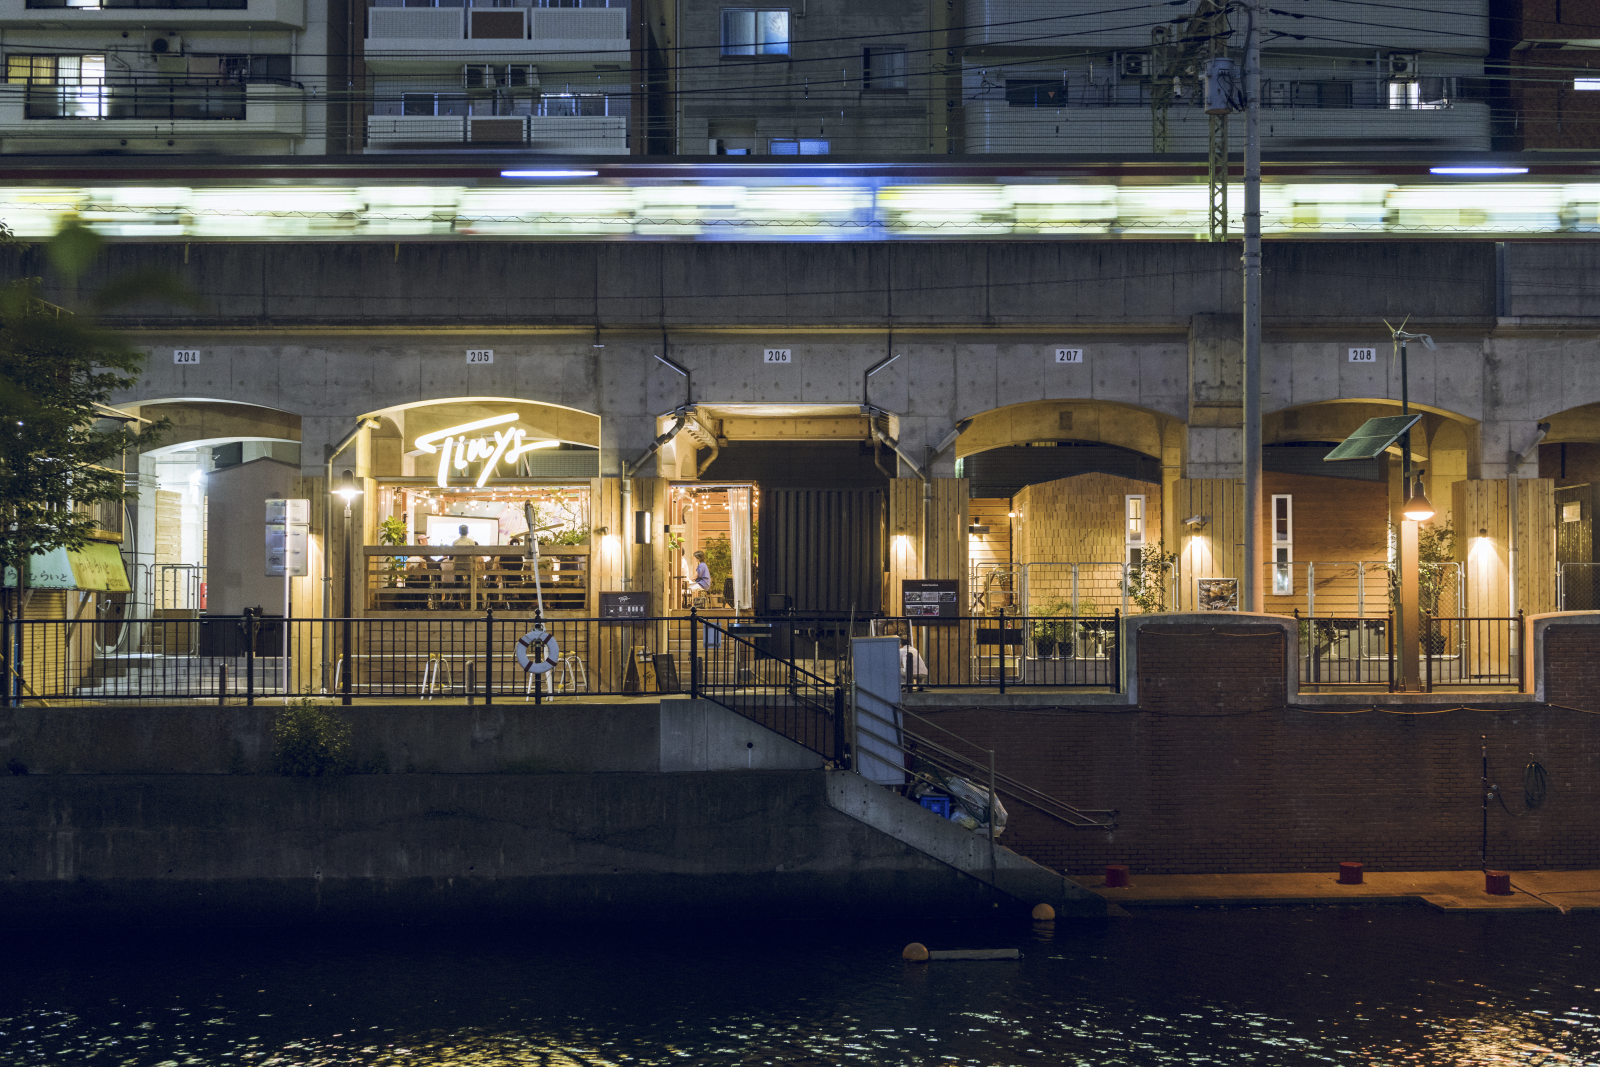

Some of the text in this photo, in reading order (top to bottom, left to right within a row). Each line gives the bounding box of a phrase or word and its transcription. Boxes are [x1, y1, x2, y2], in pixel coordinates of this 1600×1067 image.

[177, 352, 196, 363] 204
[470, 351, 489, 362] 205
[768, 350, 787, 361] 206
[1059, 350, 1078, 361] 207
[1352, 349, 1372, 360] 208
[414, 412, 561, 488] Tinys
